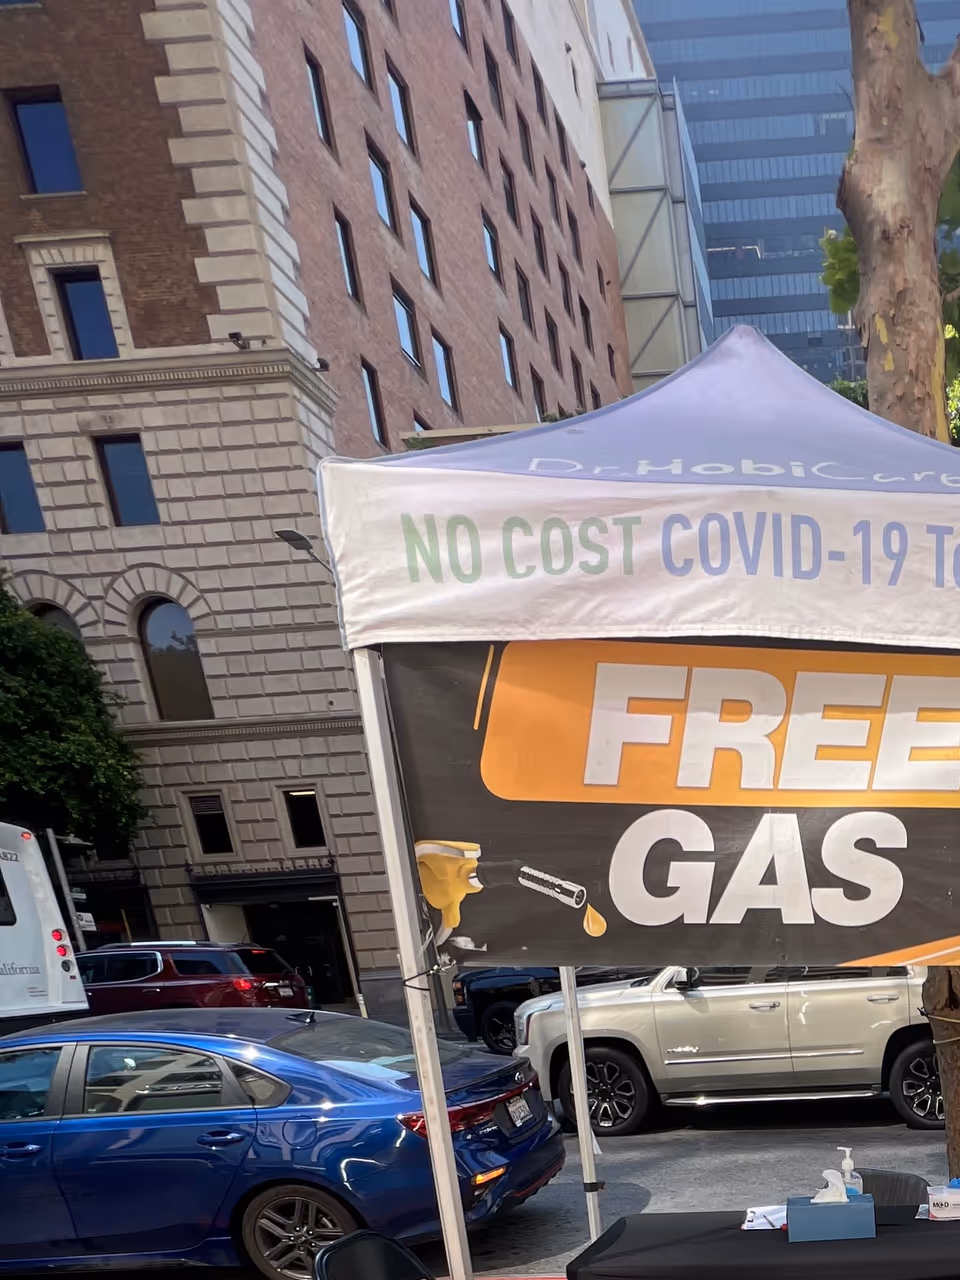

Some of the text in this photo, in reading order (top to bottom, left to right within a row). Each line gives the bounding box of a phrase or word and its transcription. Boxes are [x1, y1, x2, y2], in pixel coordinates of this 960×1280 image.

[401, 512, 483, 584] NO
[502, 515, 642, 580] COST
[661, 511, 909, 587] COVID-19
[608, 808, 909, 927] GAS
